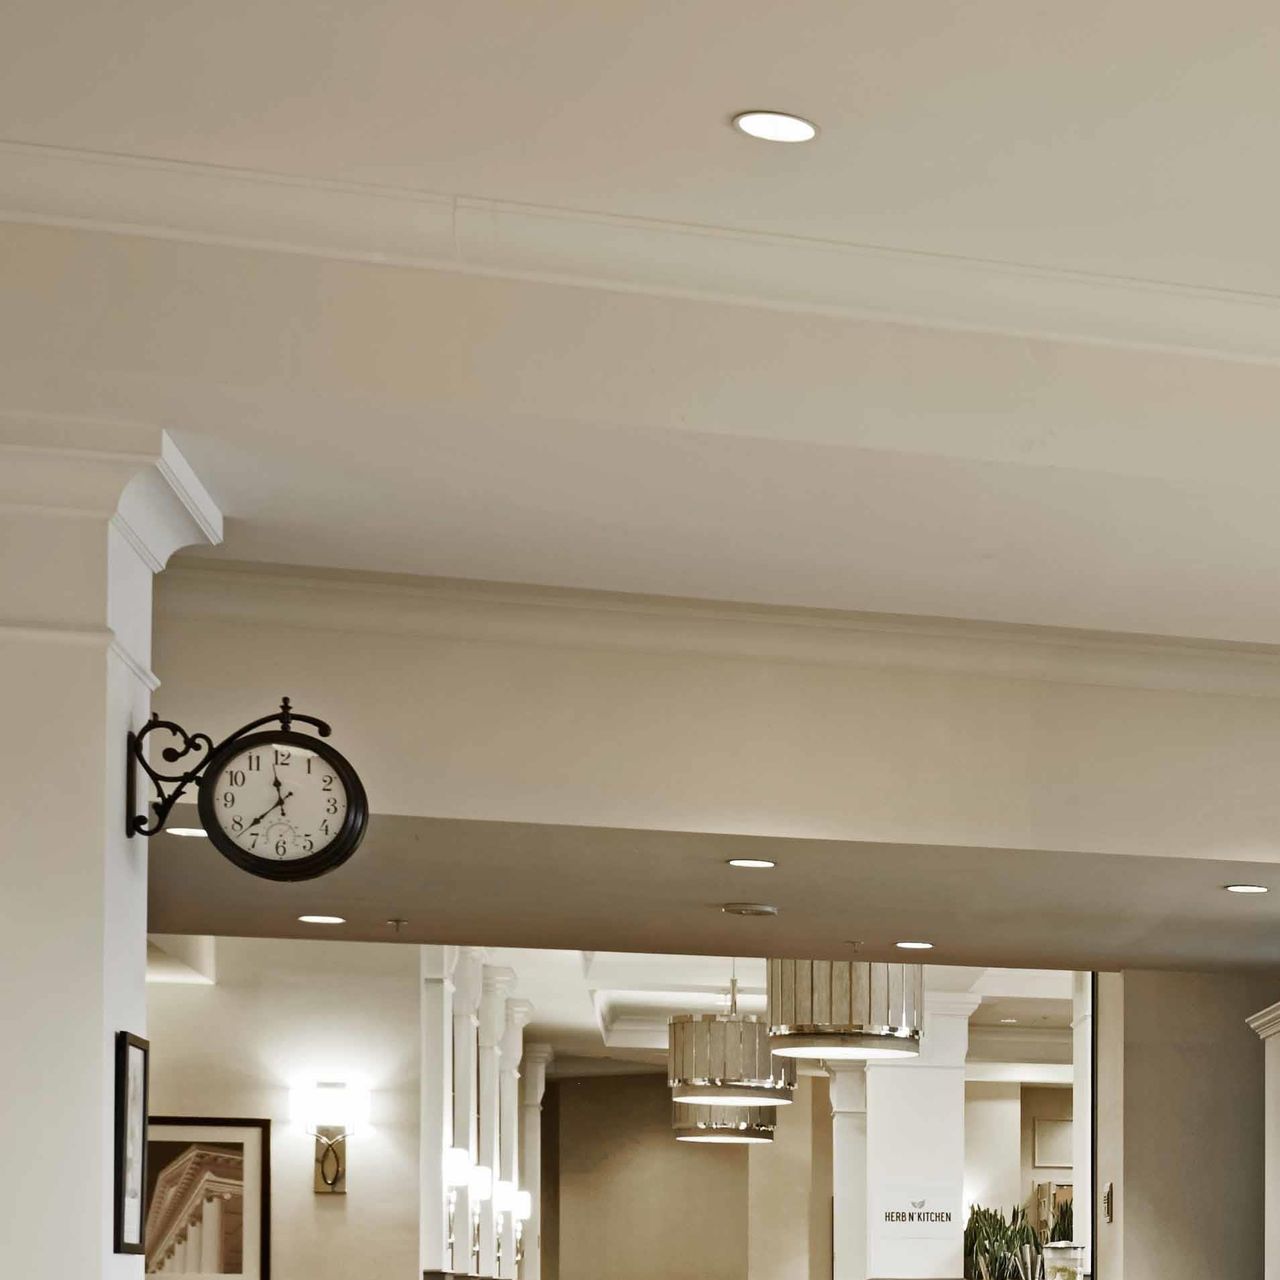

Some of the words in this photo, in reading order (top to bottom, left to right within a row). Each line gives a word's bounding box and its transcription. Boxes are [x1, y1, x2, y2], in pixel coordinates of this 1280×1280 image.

[248, 755, 260, 771] 11
[275, 750, 291, 766] 12
[306, 758, 311, 774] 1
[229, 770, 246, 787] 10
[322, 775, 333, 792] 2
[223, 792, 235, 808] 9
[326, 798, 338, 814] 3
[231, 815, 243, 832] 8
[319, 819, 329, 835] 4
[250, 833, 259, 849] 7
[275, 840, 286, 856] 6
[302, 834, 314, 851] 5
[884, 1211, 907, 1222] HERB
[917, 1211, 952, 1222] KITCHEN
